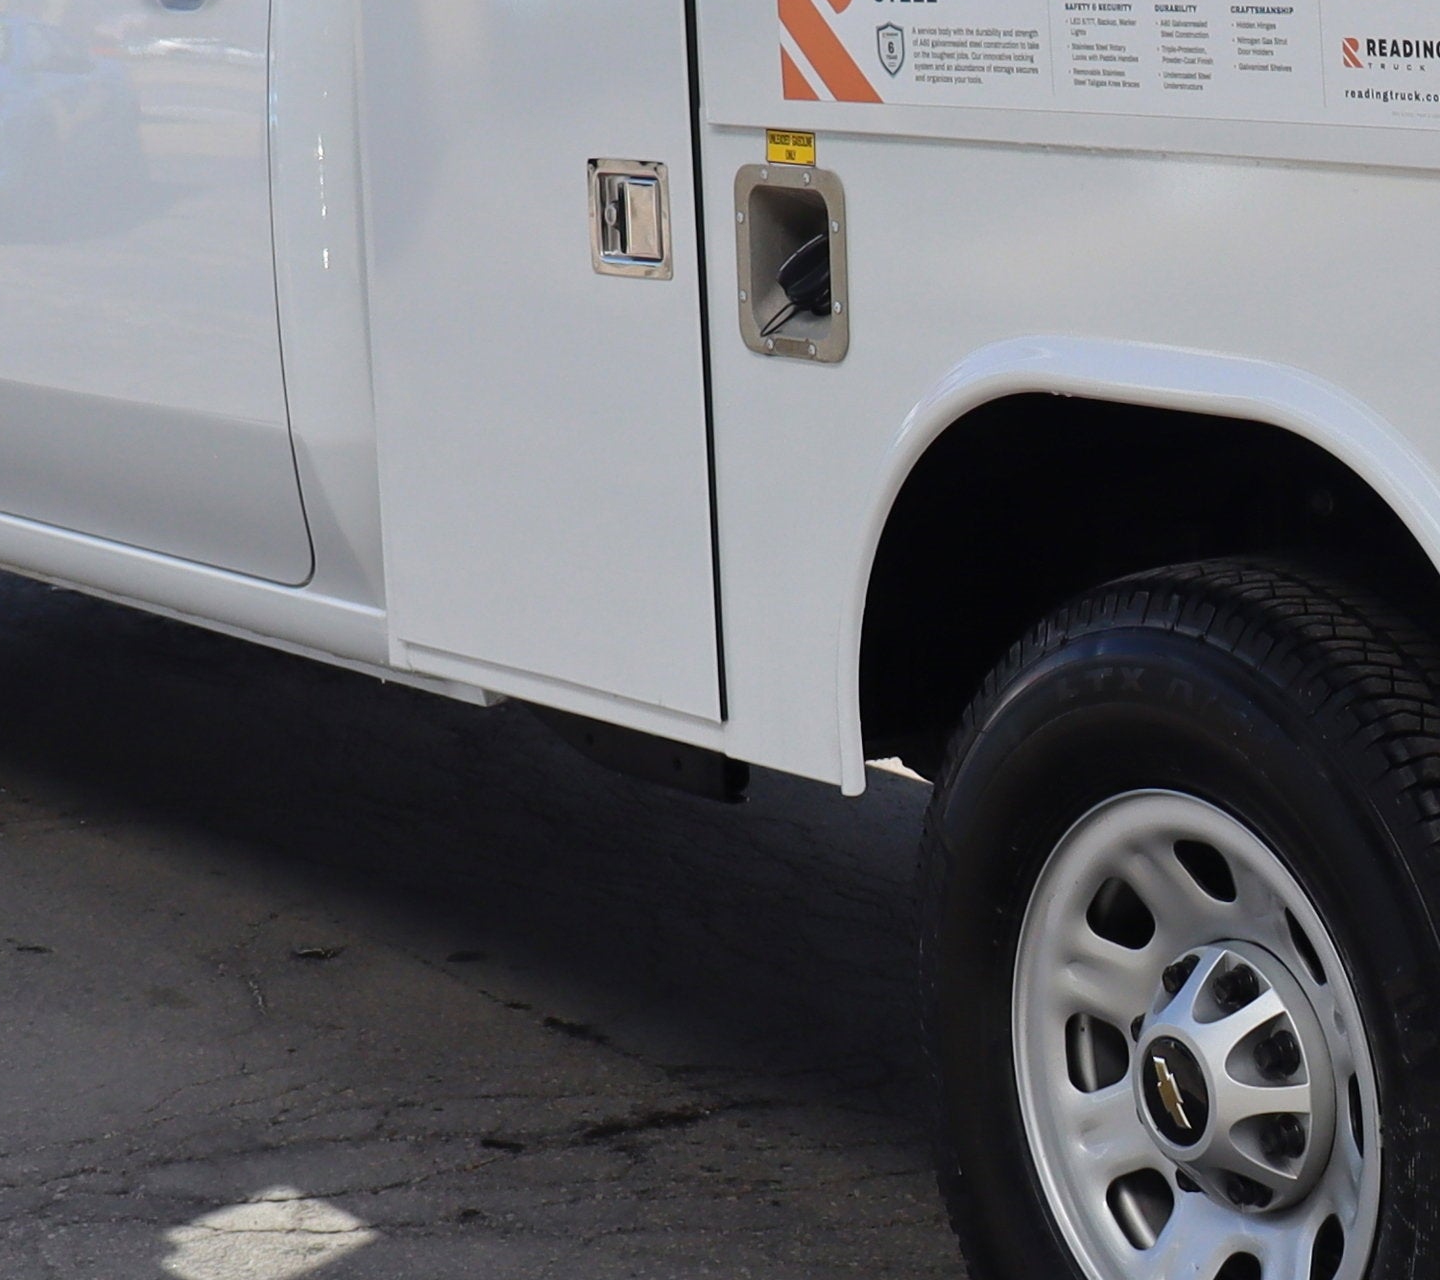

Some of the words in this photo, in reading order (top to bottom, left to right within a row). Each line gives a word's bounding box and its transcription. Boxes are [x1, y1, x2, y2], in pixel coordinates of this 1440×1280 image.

[1065, 2, 1091, 11] SAFETY
[1098, 3, 1132, 12] SECURITY
[1154, 4, 1197, 13] DURABILITY
[1230, 5, 1294, 14] CRAFTSMANSHIP
[888, 41, 895, 54] 6
[1367, 62, 1426, 72] TRUCK
